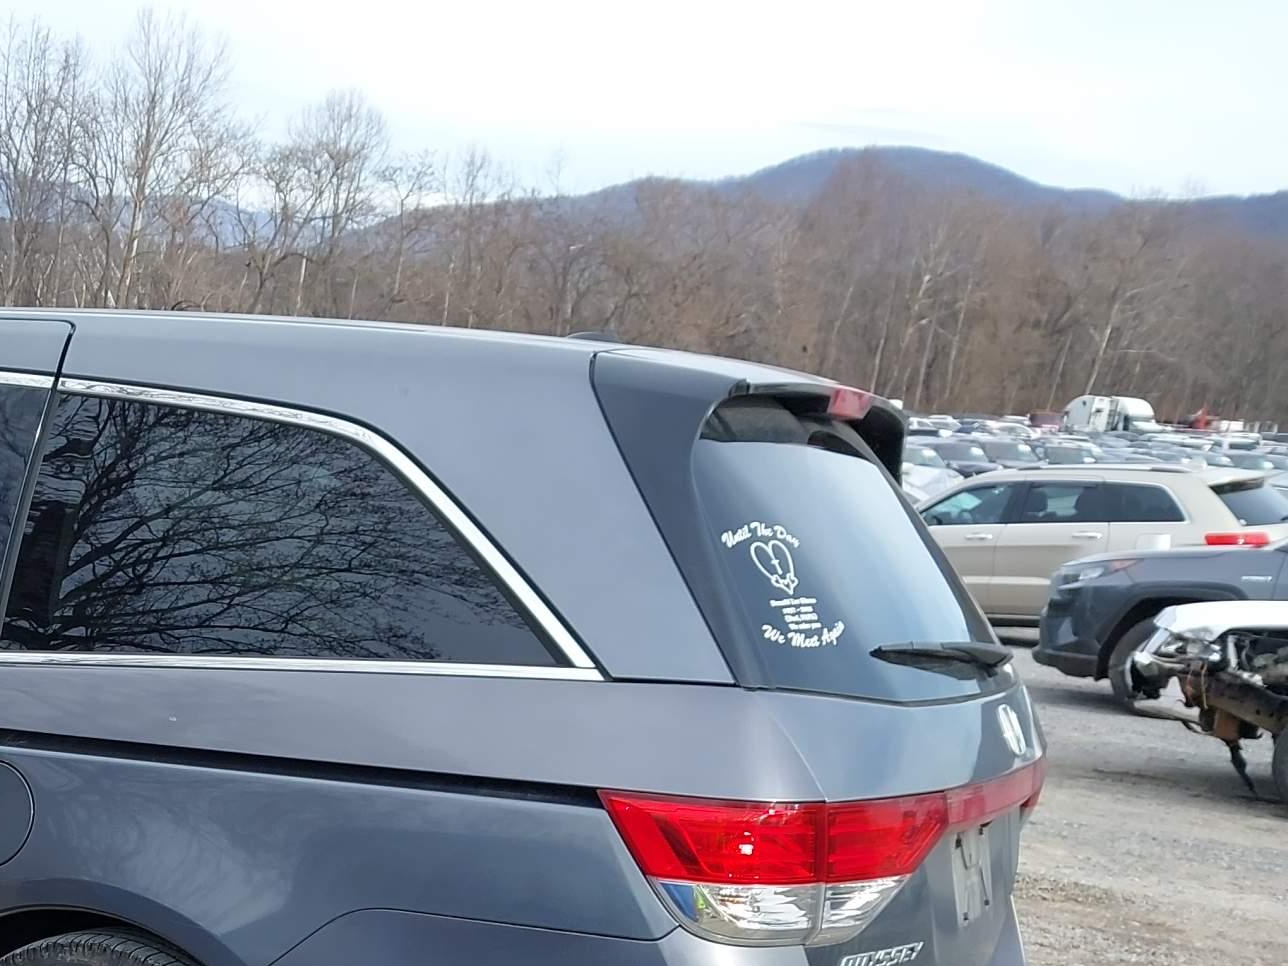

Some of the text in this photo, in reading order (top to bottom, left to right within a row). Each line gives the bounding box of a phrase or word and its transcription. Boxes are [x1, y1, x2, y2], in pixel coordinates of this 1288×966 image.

[750, 521, 774, 537] The
[773, 525, 800, 548] Day
[761, 624, 786, 644] We
